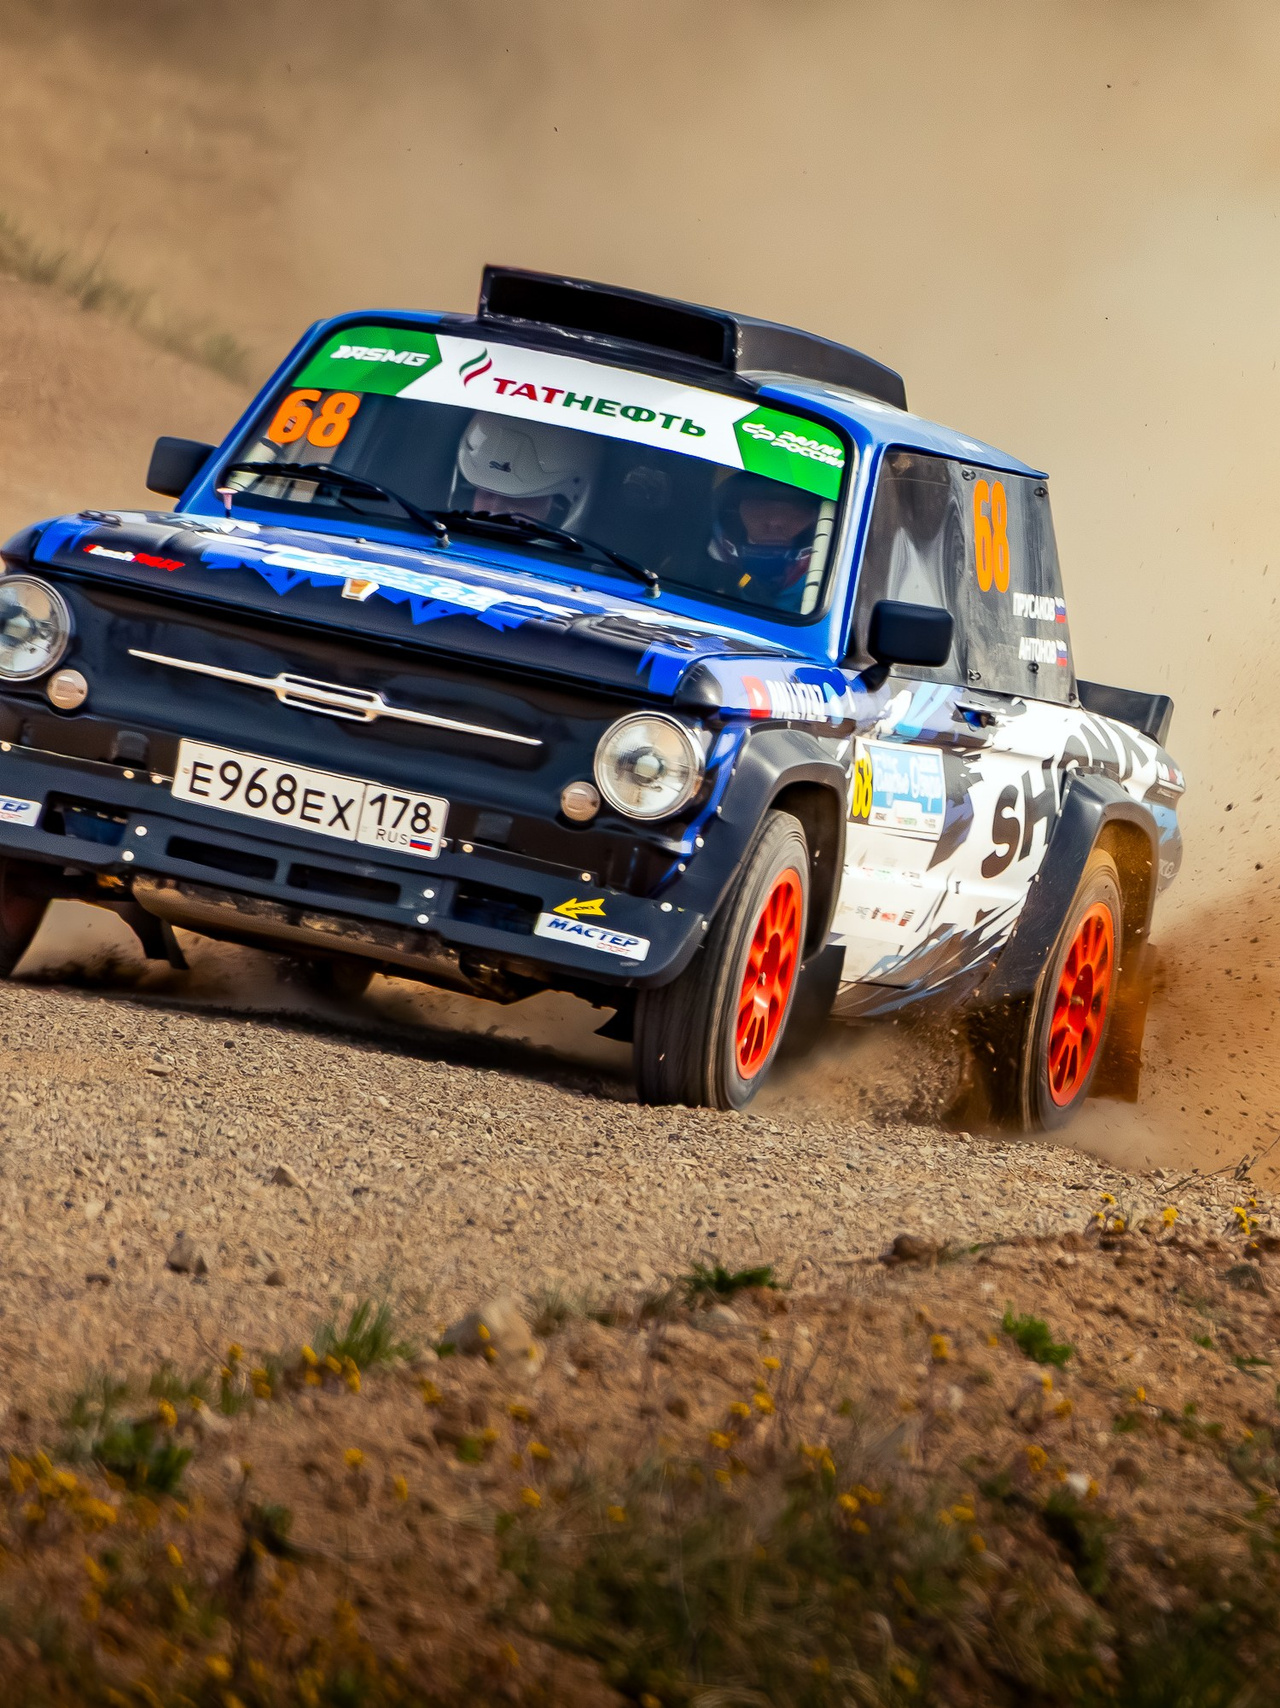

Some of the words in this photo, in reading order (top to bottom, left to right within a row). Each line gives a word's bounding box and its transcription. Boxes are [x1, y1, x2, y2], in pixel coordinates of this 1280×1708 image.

[268, 388, 361, 448] 68
[493, 377, 706, 437] ТАТНЕФТЬ
[973, 479, 1010, 593] 68
[188, 759, 355, 831] Е968ЕХ
[369, 792, 432, 834] 178
[852, 750, 873, 818] 68
[375, 828, 408, 846] RUS
[547, 918, 640, 947] МАСТЕР
